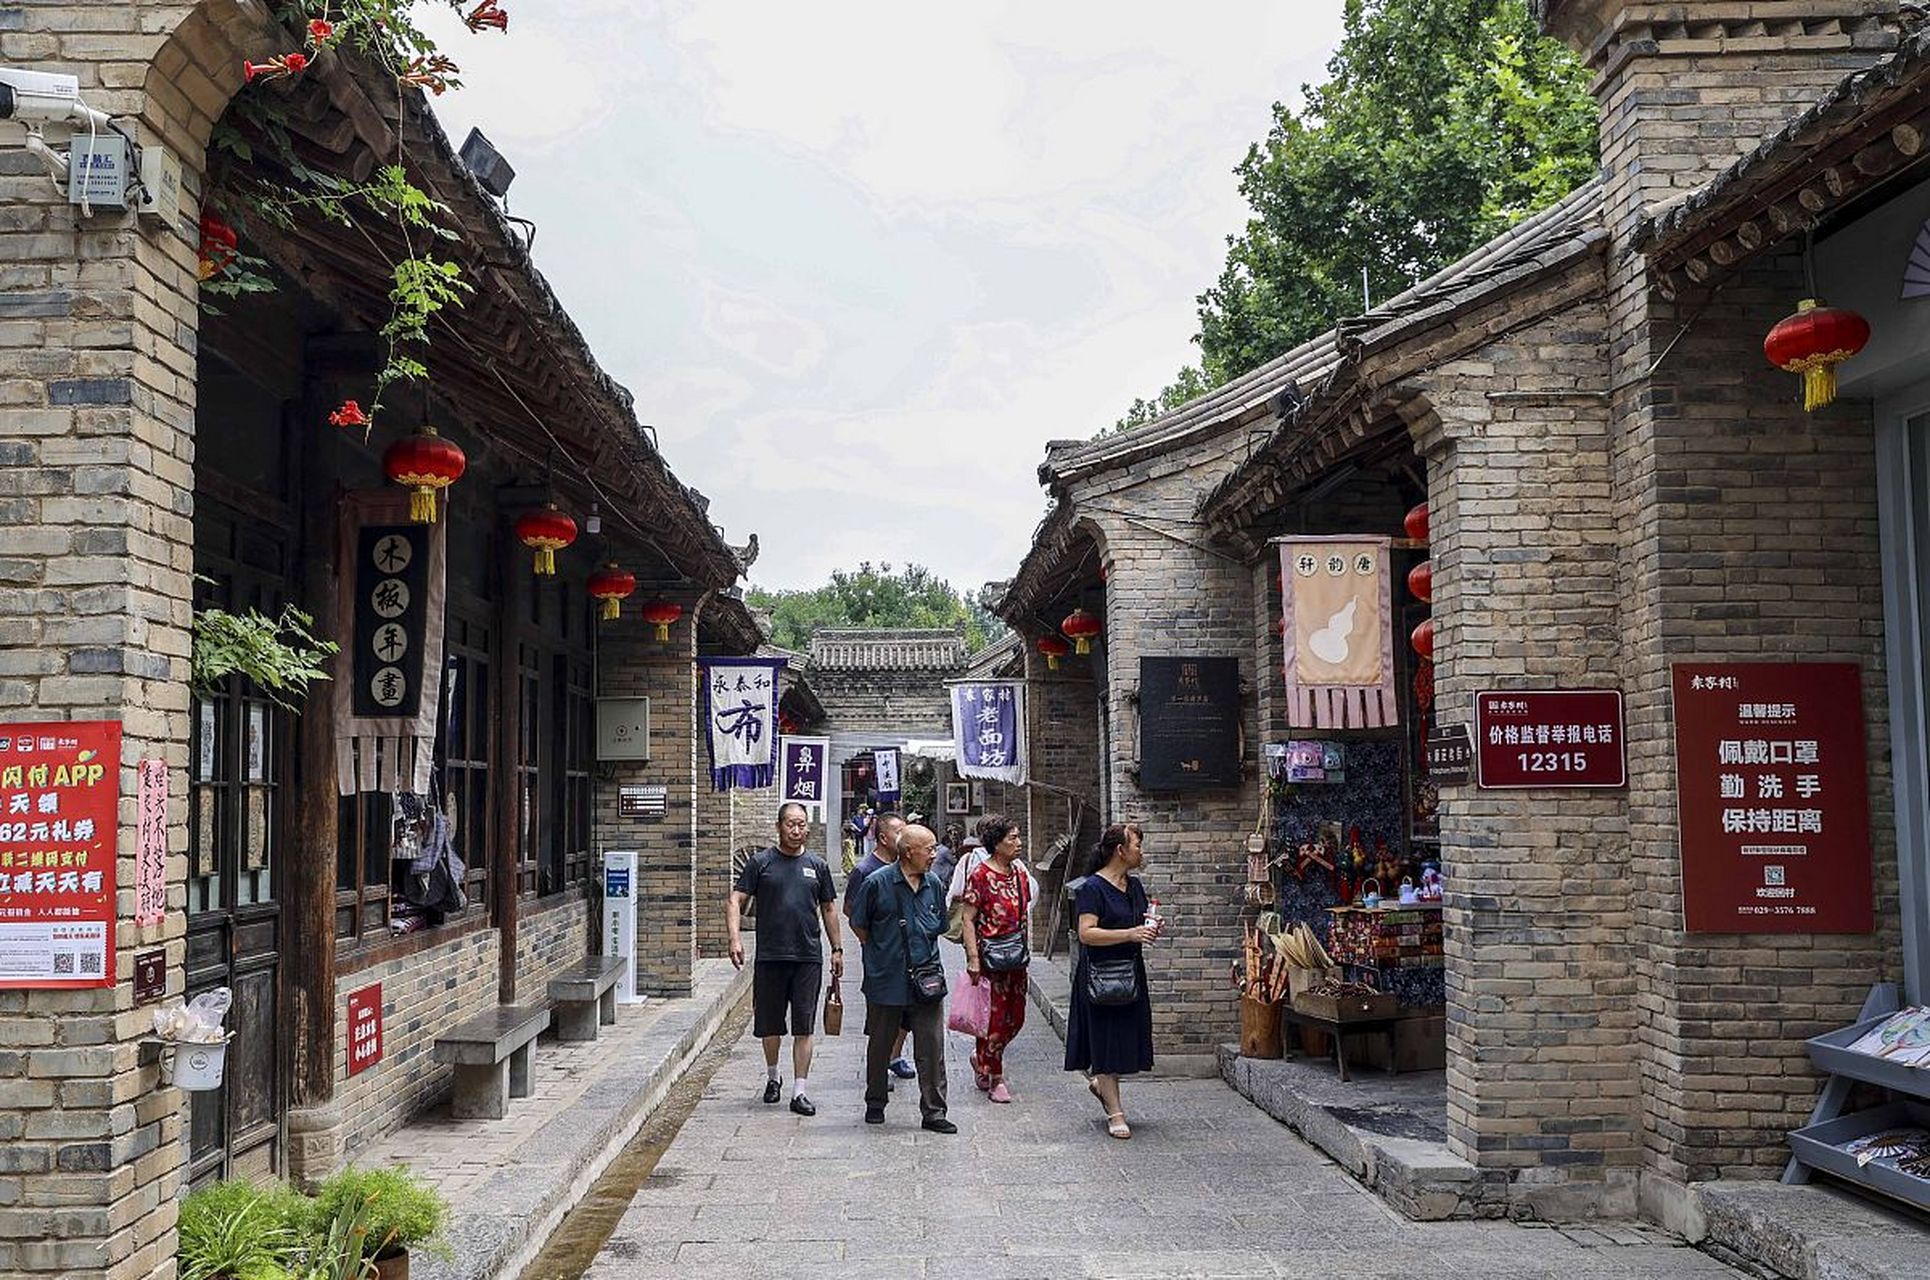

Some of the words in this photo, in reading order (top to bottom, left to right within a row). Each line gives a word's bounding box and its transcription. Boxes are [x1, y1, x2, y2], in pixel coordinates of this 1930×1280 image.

[375, 538, 407, 702] 木板年畫
[1739, 703, 1797, 718] 温馨提示
[714, 699, 767, 755] 布
[975, 706, 1007, 767] 老面坊
[1489, 724, 1613, 745] 价格监督举报电话
[1518, 752, 1587, 772] 12315
[1718, 740, 1820, 764] 佩戴口罩
[792, 746, 817, 800] 鼻烟
[1719, 773, 1822, 798] 勤洗手
[0, 792, 59, 815] 天领
[1721, 808, 1823, 833] 保持距离
